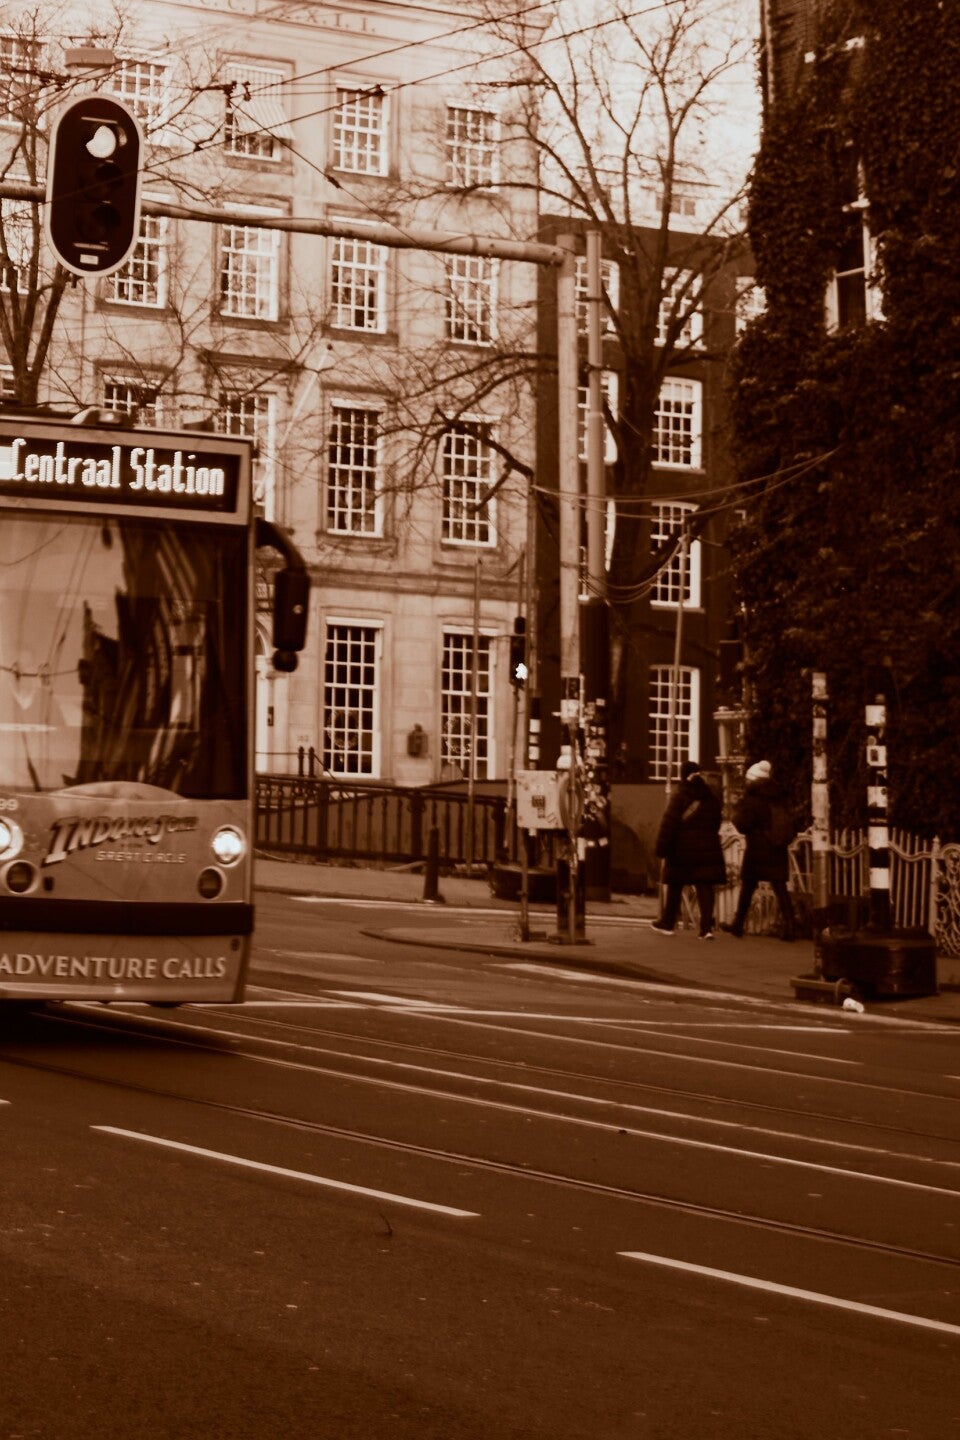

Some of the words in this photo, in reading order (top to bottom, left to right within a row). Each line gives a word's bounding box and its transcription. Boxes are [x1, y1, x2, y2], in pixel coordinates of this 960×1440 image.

[11, 437, 121, 489] Centraal
[129, 447, 225, 496] Station
[162, 956, 226, 981] CALLS
